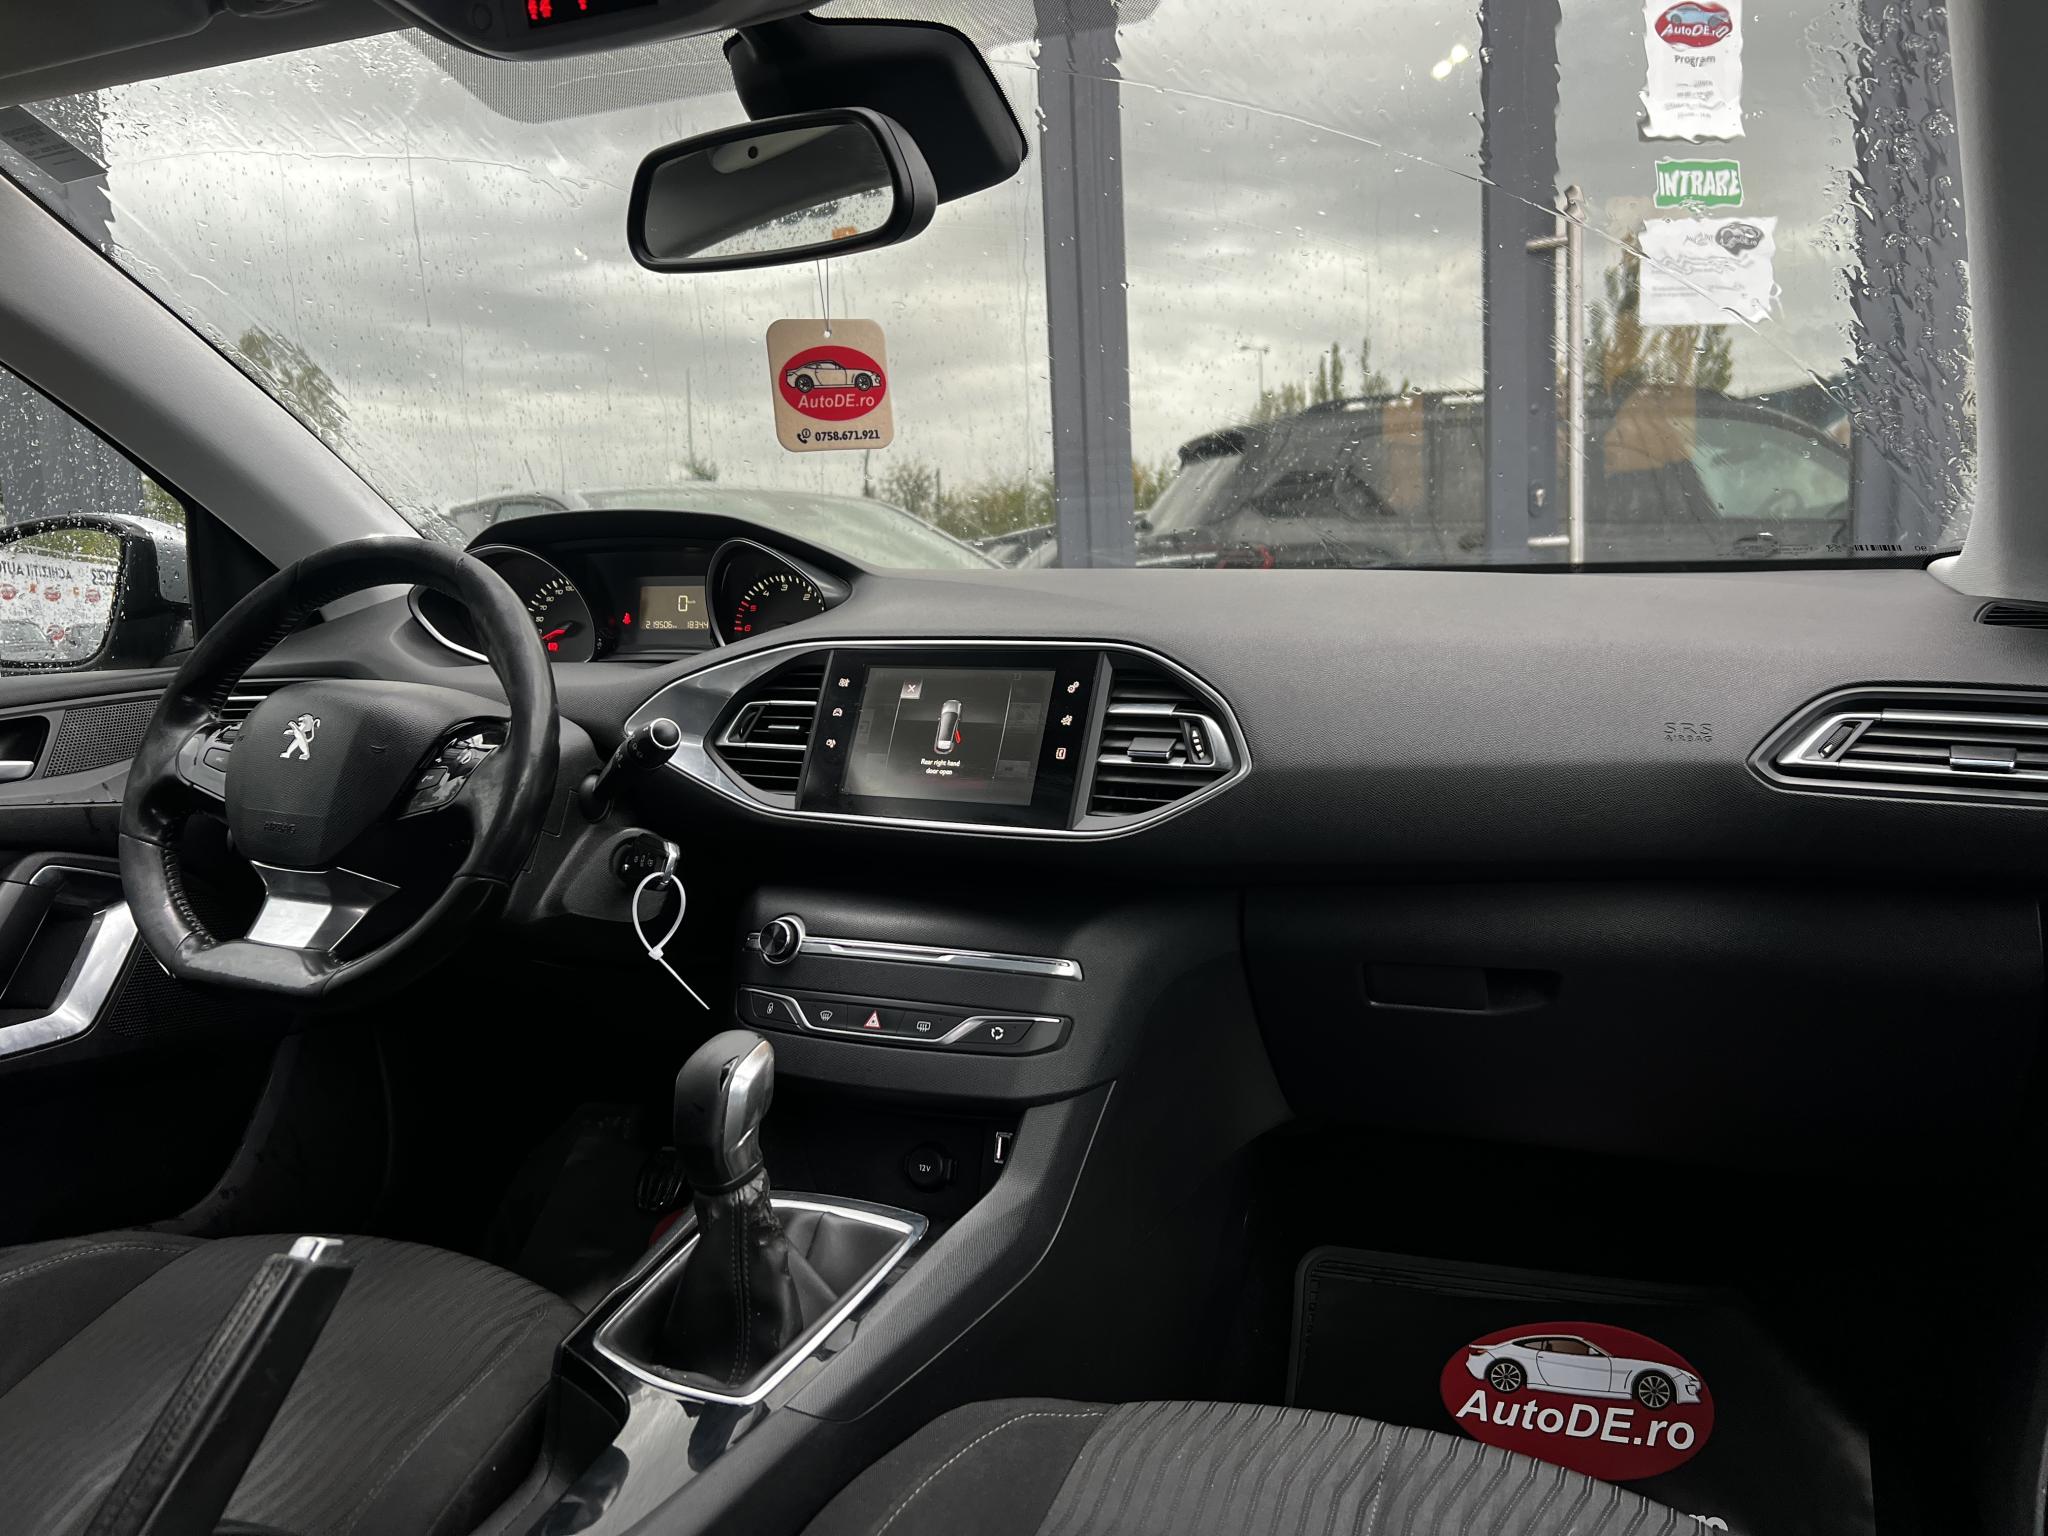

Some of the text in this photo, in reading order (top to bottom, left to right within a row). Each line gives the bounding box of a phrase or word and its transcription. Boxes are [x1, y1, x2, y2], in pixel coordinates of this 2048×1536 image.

[1674, 54, 1716, 67] Program
[1659, 169, 1740, 197] INTRARE
[798, 393, 875, 409] AutoDE.ro
[815, 430, 880, 441] 0758.671.921
[803, 593, 811, 601] 2
[1664, 722, 1712, 735] SRS
[933, 759, 947, 767] right
[947, 759, 960, 767] hand
[919, 1163, 931, 1172] 12V
[1456, 1389, 1695, 1450] AutoDE.ro
